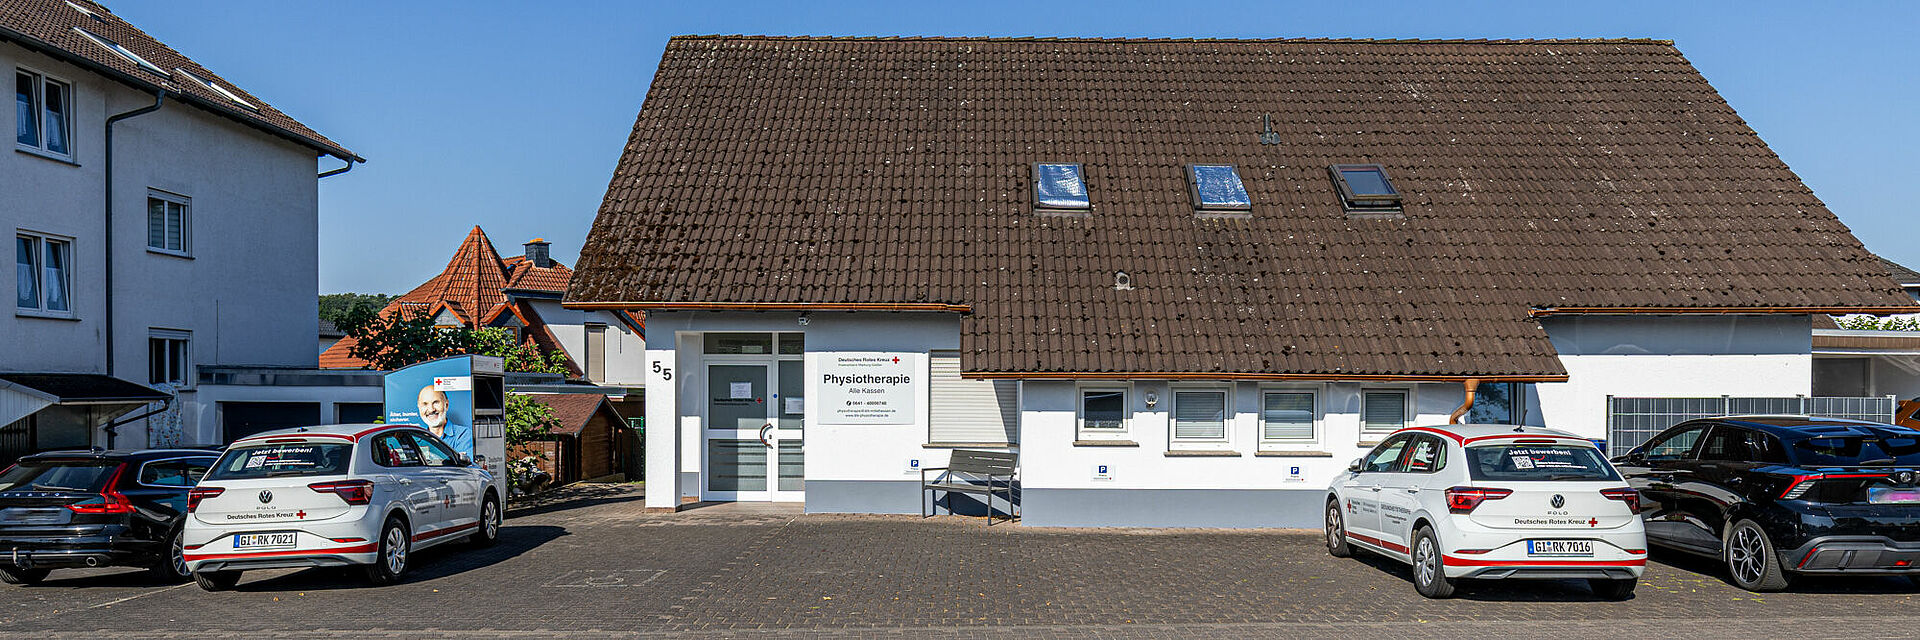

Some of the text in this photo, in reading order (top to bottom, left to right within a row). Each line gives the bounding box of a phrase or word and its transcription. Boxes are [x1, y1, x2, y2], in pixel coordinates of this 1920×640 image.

[823, 374, 911, 387] Physiotherapie
[1529, 448, 1571, 456] bewerben!
[240, 534, 294, 546] GI RK 7021
[1535, 541, 1591, 552] GI RK 7016
